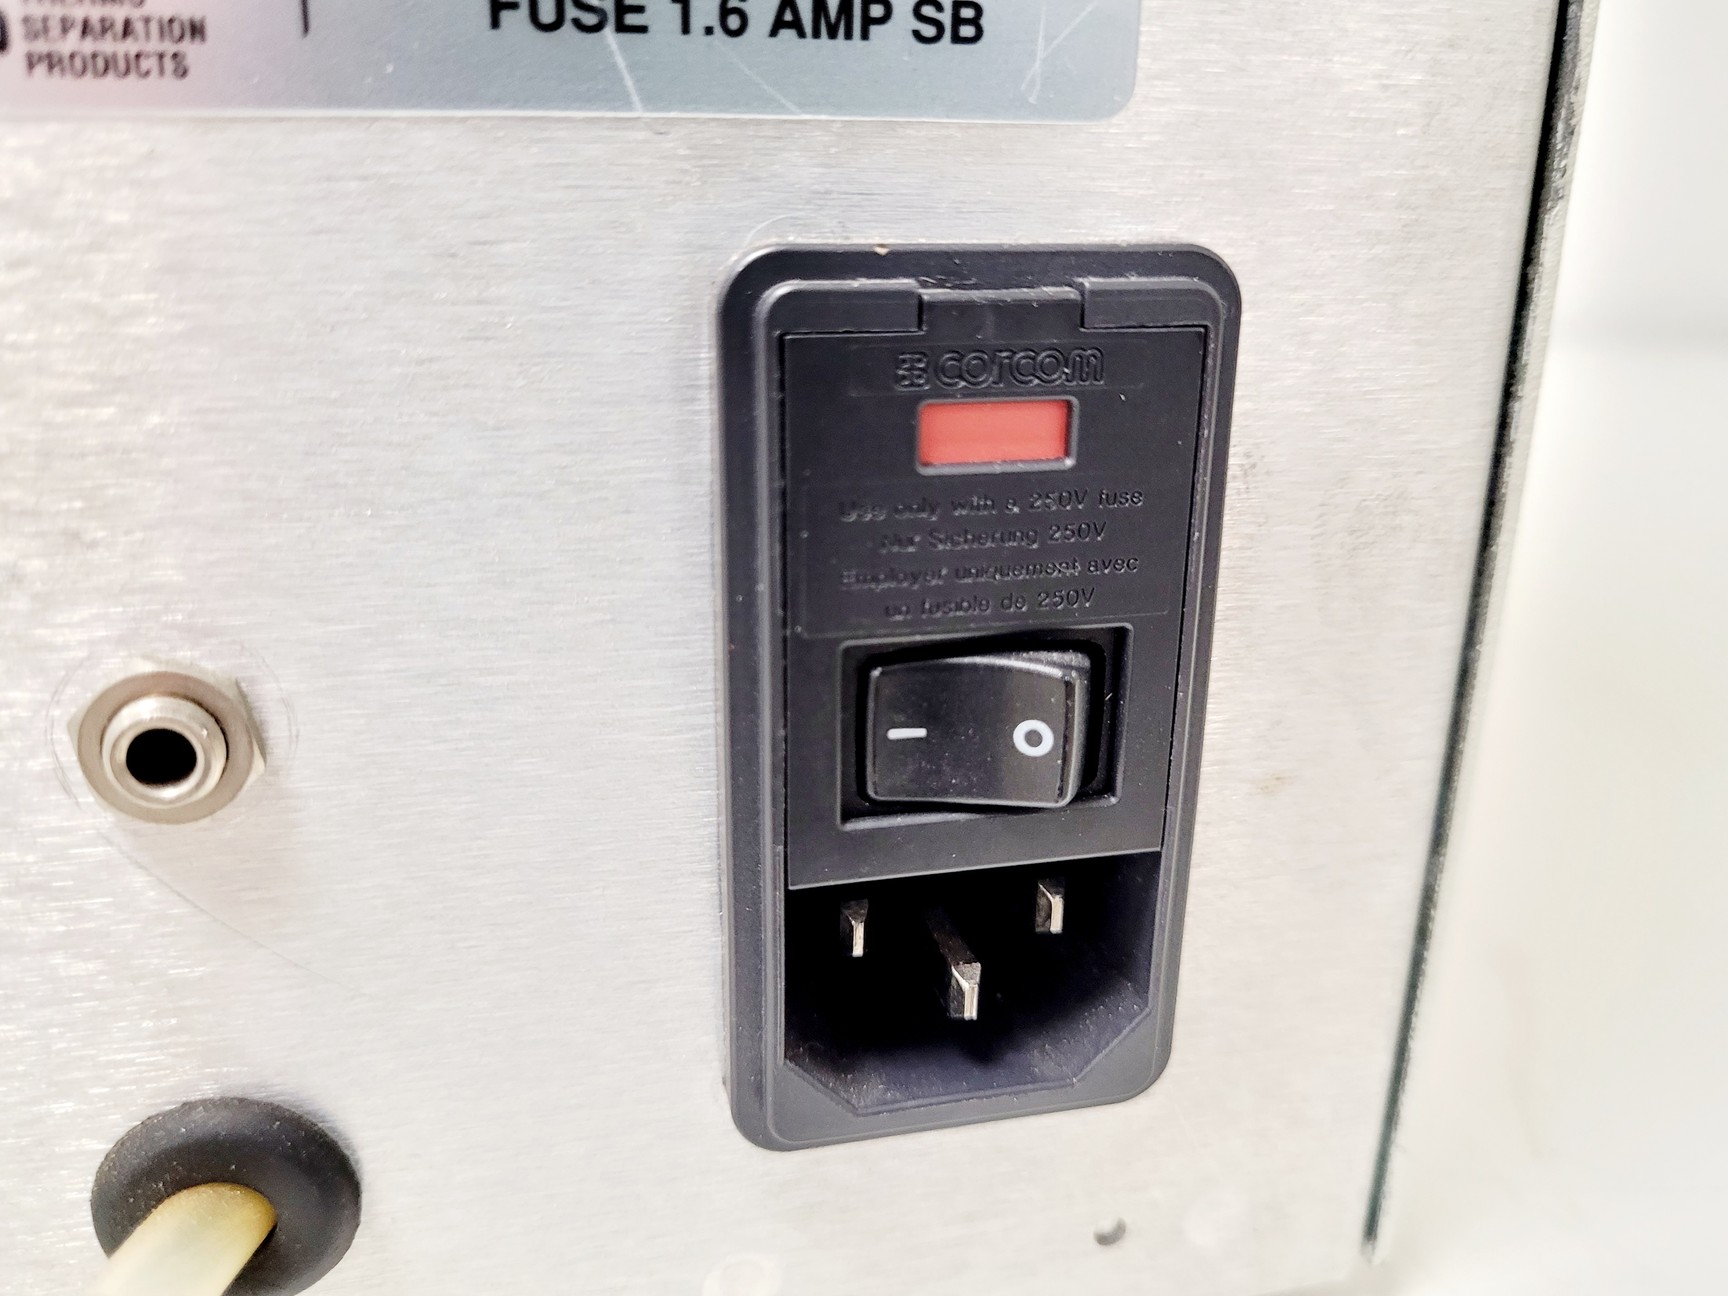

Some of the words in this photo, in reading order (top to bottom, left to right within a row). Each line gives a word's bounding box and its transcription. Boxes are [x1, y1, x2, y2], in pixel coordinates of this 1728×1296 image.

[21, 15, 206, 42] SEPARATION
[490, 0, 648, 34] FUSE
[671, 0, 749, 38] 1.6
[769, 0, 893, 41] AMP
[911, 0, 983, 44] SB
[24, 51, 189, 79] PRODUCTS
[839, 499, 887, 522] Use
[893, 497, 940, 522] only
[952, 495, 997, 516] with
[1005, 497, 1020, 513] a
[1028, 488, 1088, 512] 250V
[1099, 488, 1143, 509] fuse
[929, 528, 1039, 550] Sicherung
[1048, 521, 1106, 544] 250V
[840, 567, 948, 592] Employer
[955, 557, 1081, 584] uniquement
[1087, 557, 1139, 576] avec
[885, 605, 912, 621] un
[921, 595, 992, 619] fusible
[1001, 591, 1027, 612] de
[1037, 586, 1095, 610] 250V
